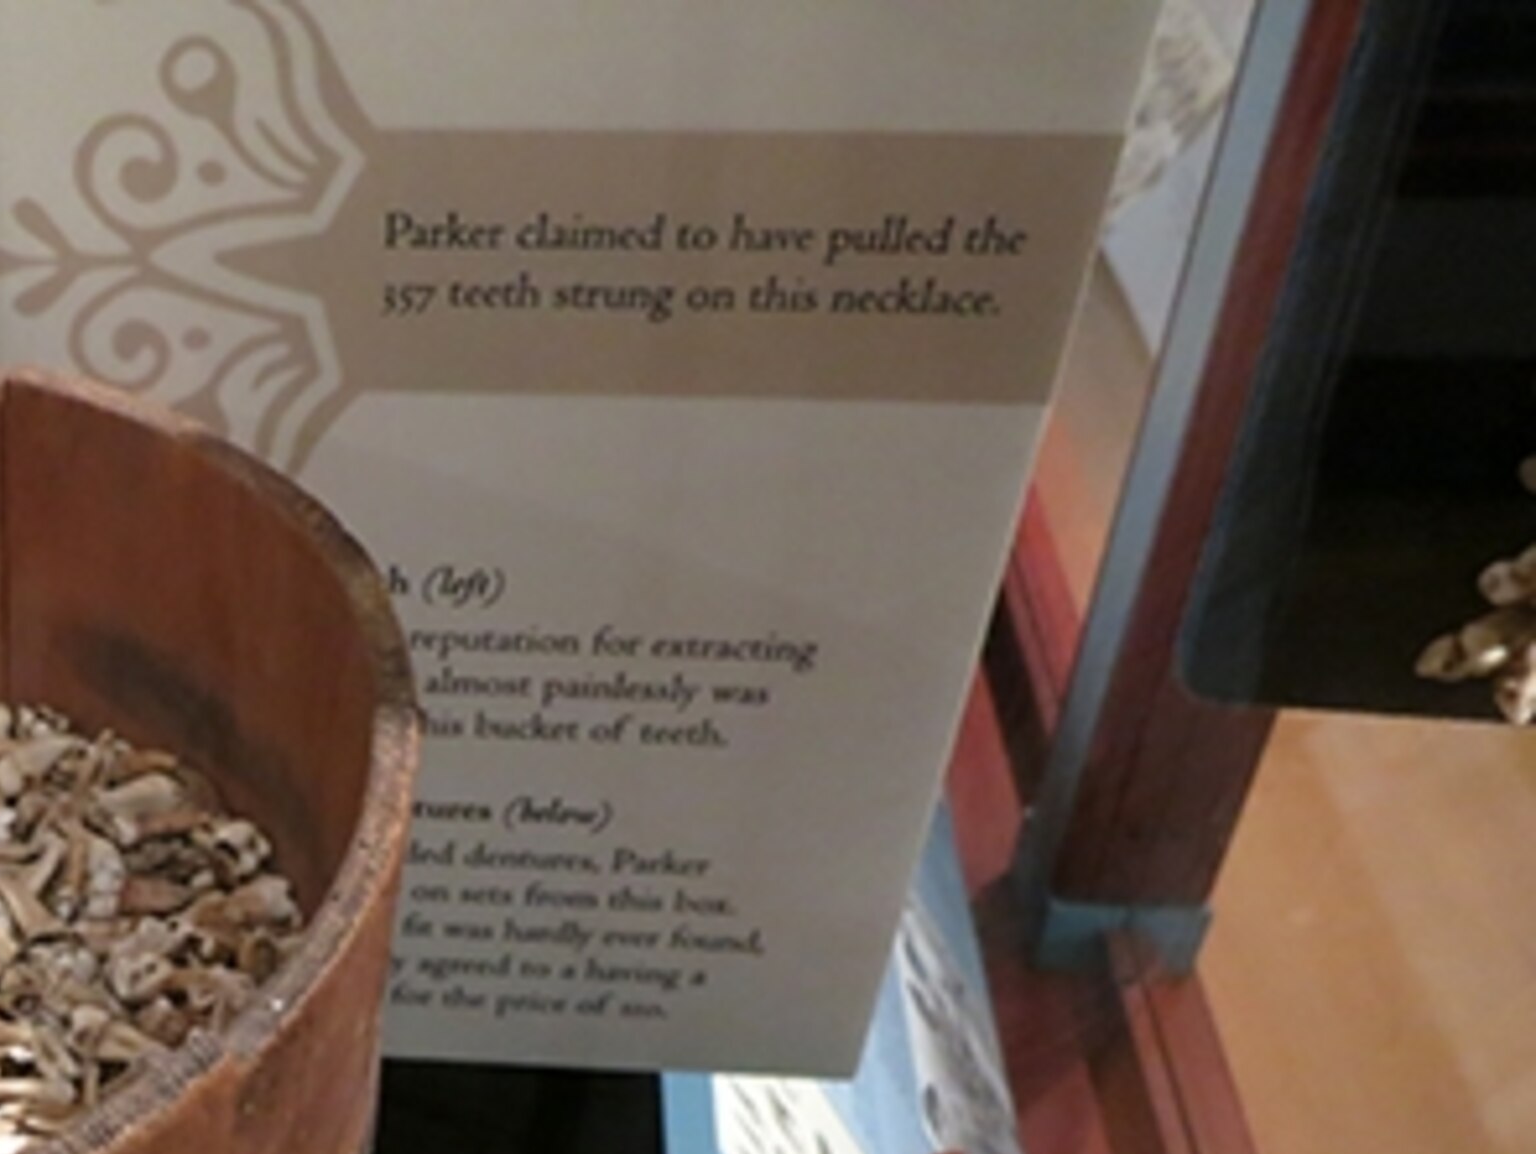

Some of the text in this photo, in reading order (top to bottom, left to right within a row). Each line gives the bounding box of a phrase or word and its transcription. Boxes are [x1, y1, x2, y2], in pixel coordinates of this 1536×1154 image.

[383, 212, 1027, 266] Parker claimed to have pulled the
[382, 272, 1001, 323] 357 teeth strung on this necklace.
[410, 624, 818, 673] reputation for extracting
[424, 668, 772, 711] almost painlessly was
[473, 713, 579, 742] bucket
[589, 714, 634, 743] of
[640, 718, 728, 747] teeth.
[463, 842, 600, 876] dentures,
[612, 847, 711, 877] Parker
[410, 884, 449, 902] on
[524, 881, 600, 910] from
[608, 886, 663, 913] this
[444, 922, 494, 942] was
[505, 917, 591, 950] hardly
[602, 928, 660, 948] ever
[417, 956, 510, 982] agreed
[520, 960, 552, 980] to
[561, 963, 576, 981] a
[584, 958, 681, 990] having
[690, 969, 707, 987] a
[390, 984, 432, 1007] for
[442, 986, 486, 1009] the
[495, 992, 566, 1018] price
[575, 993, 612, 1016] of
